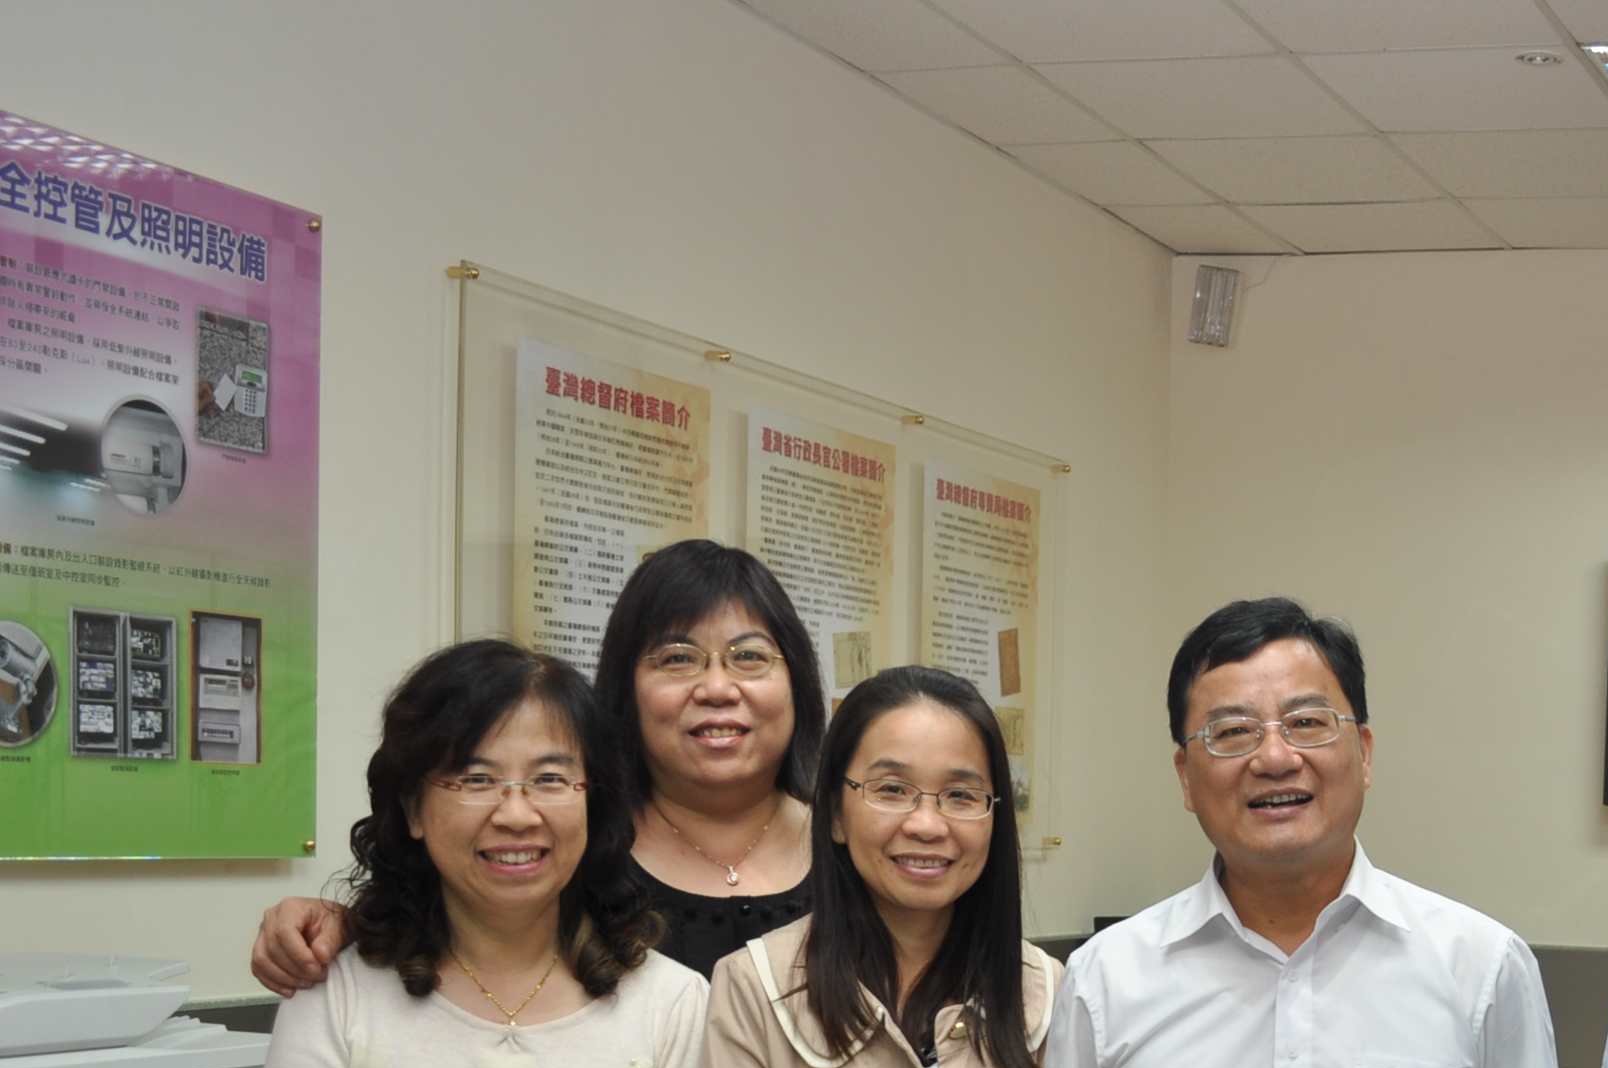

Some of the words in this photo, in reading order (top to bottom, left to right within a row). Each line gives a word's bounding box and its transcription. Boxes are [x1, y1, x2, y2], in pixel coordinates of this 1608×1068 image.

[0, 161, 267, 283] 全控管及照明設備
[545, 366, 691, 431] 臺灣總督府檔案簡介
[762, 427, 886, 484] 臺灣省行政長官公署檔案簡介
